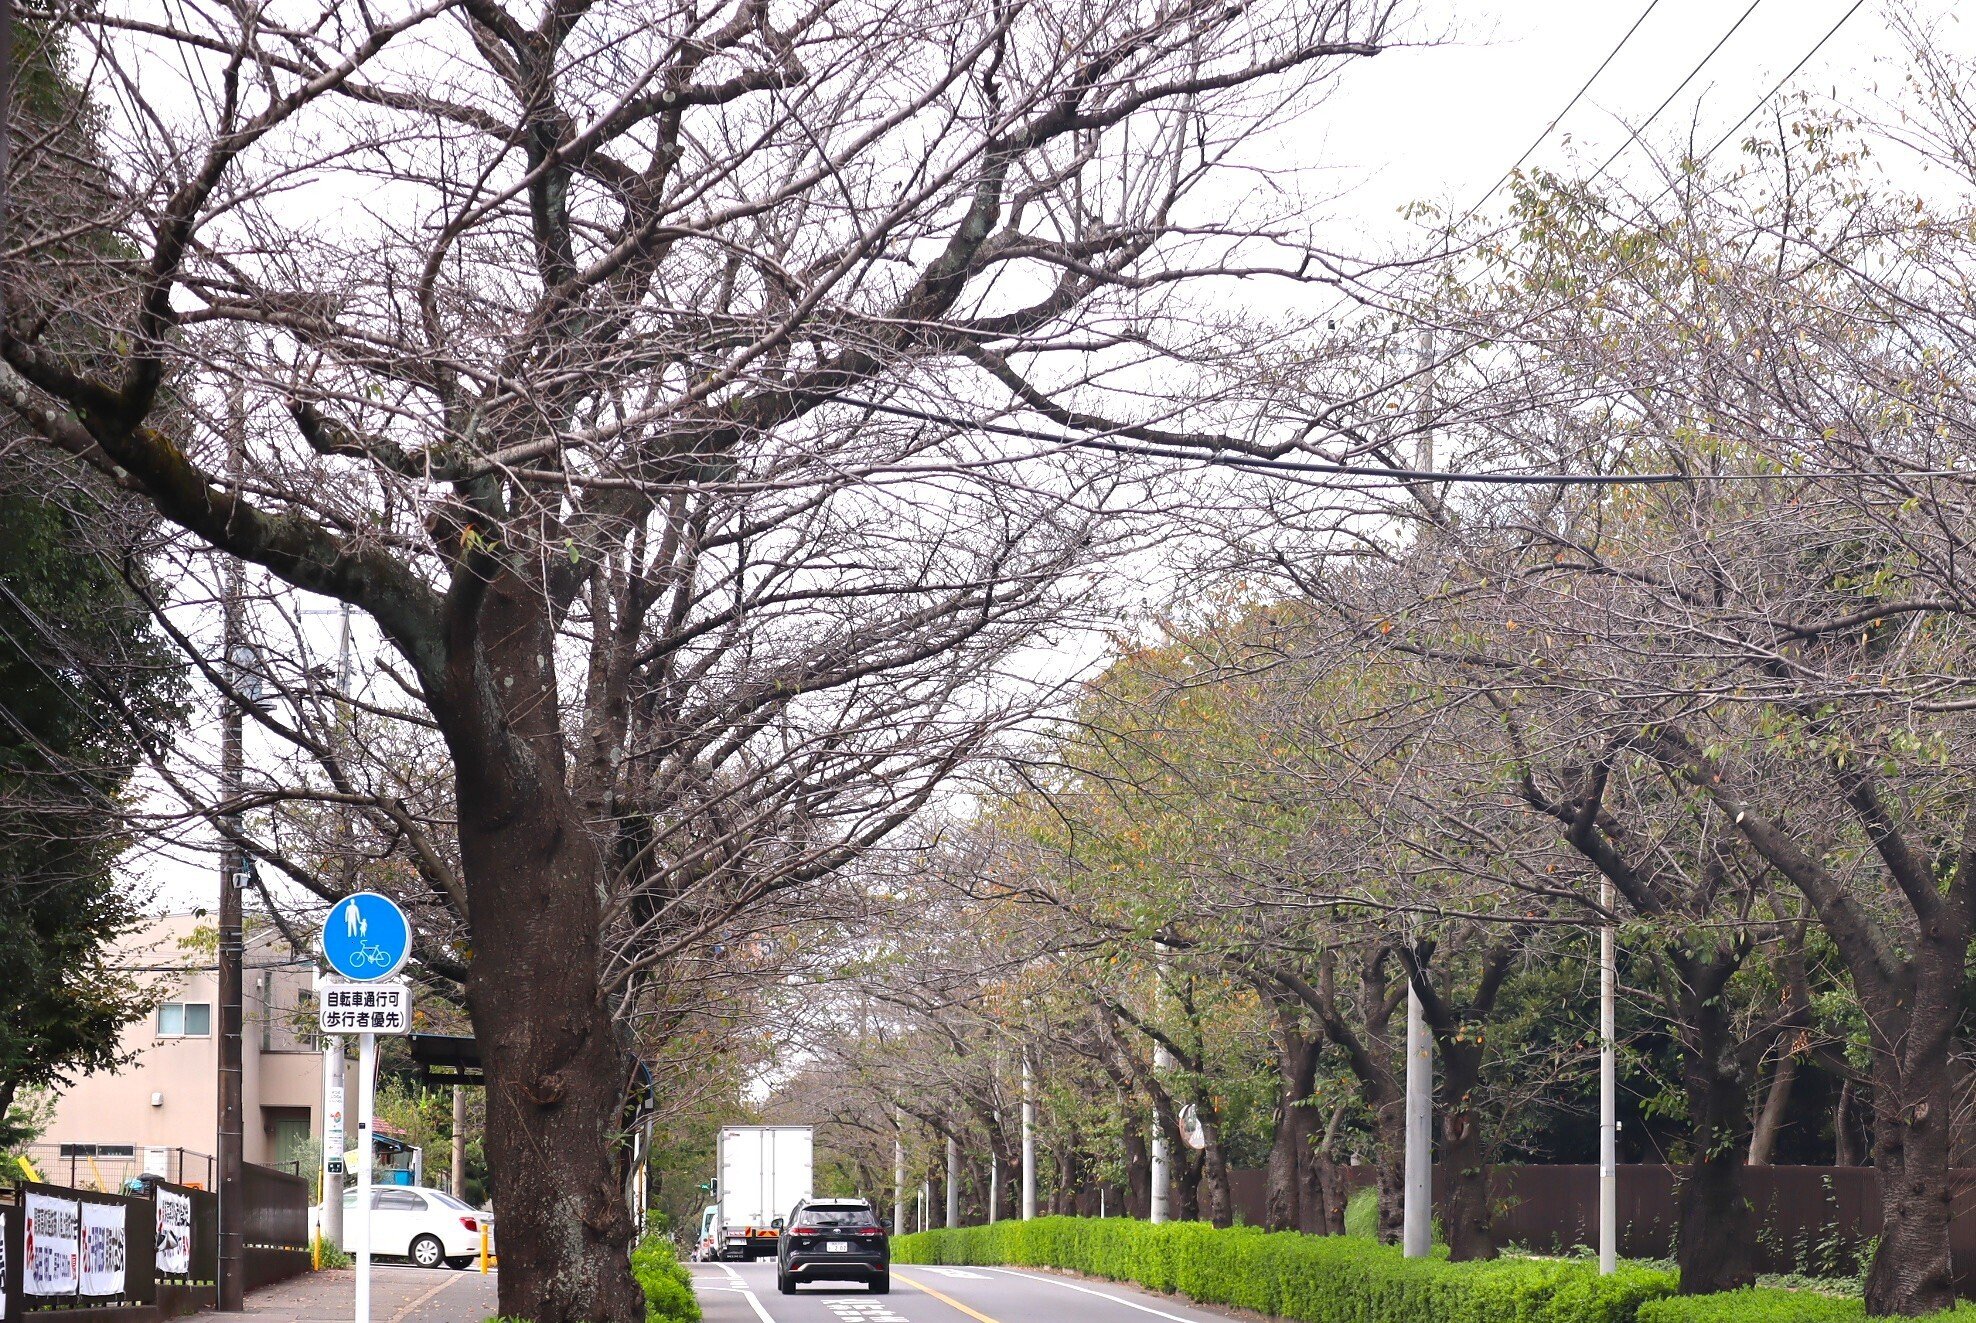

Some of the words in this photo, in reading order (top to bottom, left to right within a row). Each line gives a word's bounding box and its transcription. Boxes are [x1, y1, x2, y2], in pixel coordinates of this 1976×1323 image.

[327, 991, 400, 1007] 自転車通行可
[321, 1011, 404, 1028] (歩行者優先)
